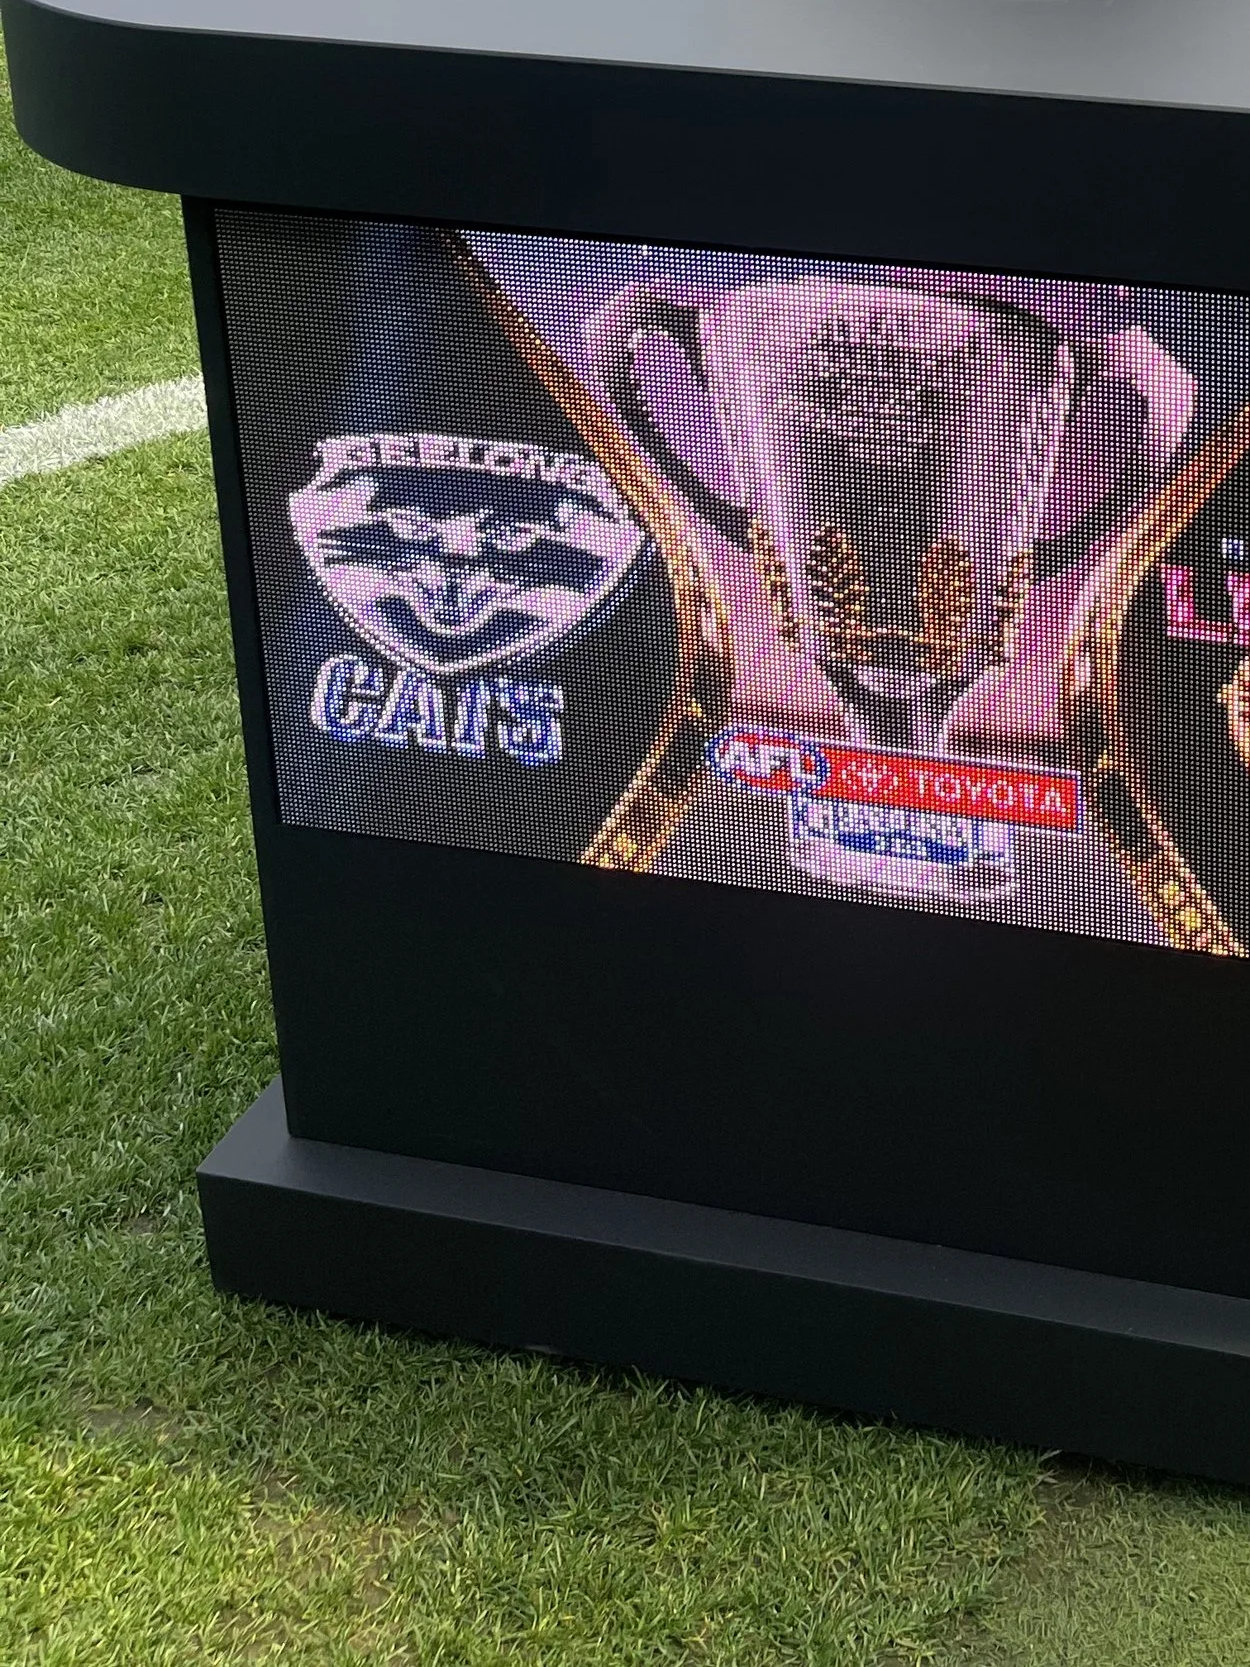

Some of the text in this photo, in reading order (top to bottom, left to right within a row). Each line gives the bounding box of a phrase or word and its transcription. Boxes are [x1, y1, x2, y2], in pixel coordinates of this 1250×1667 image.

[310, 653, 566, 767] CATS
[718, 742, 1070, 816] AFL TOYOTA
